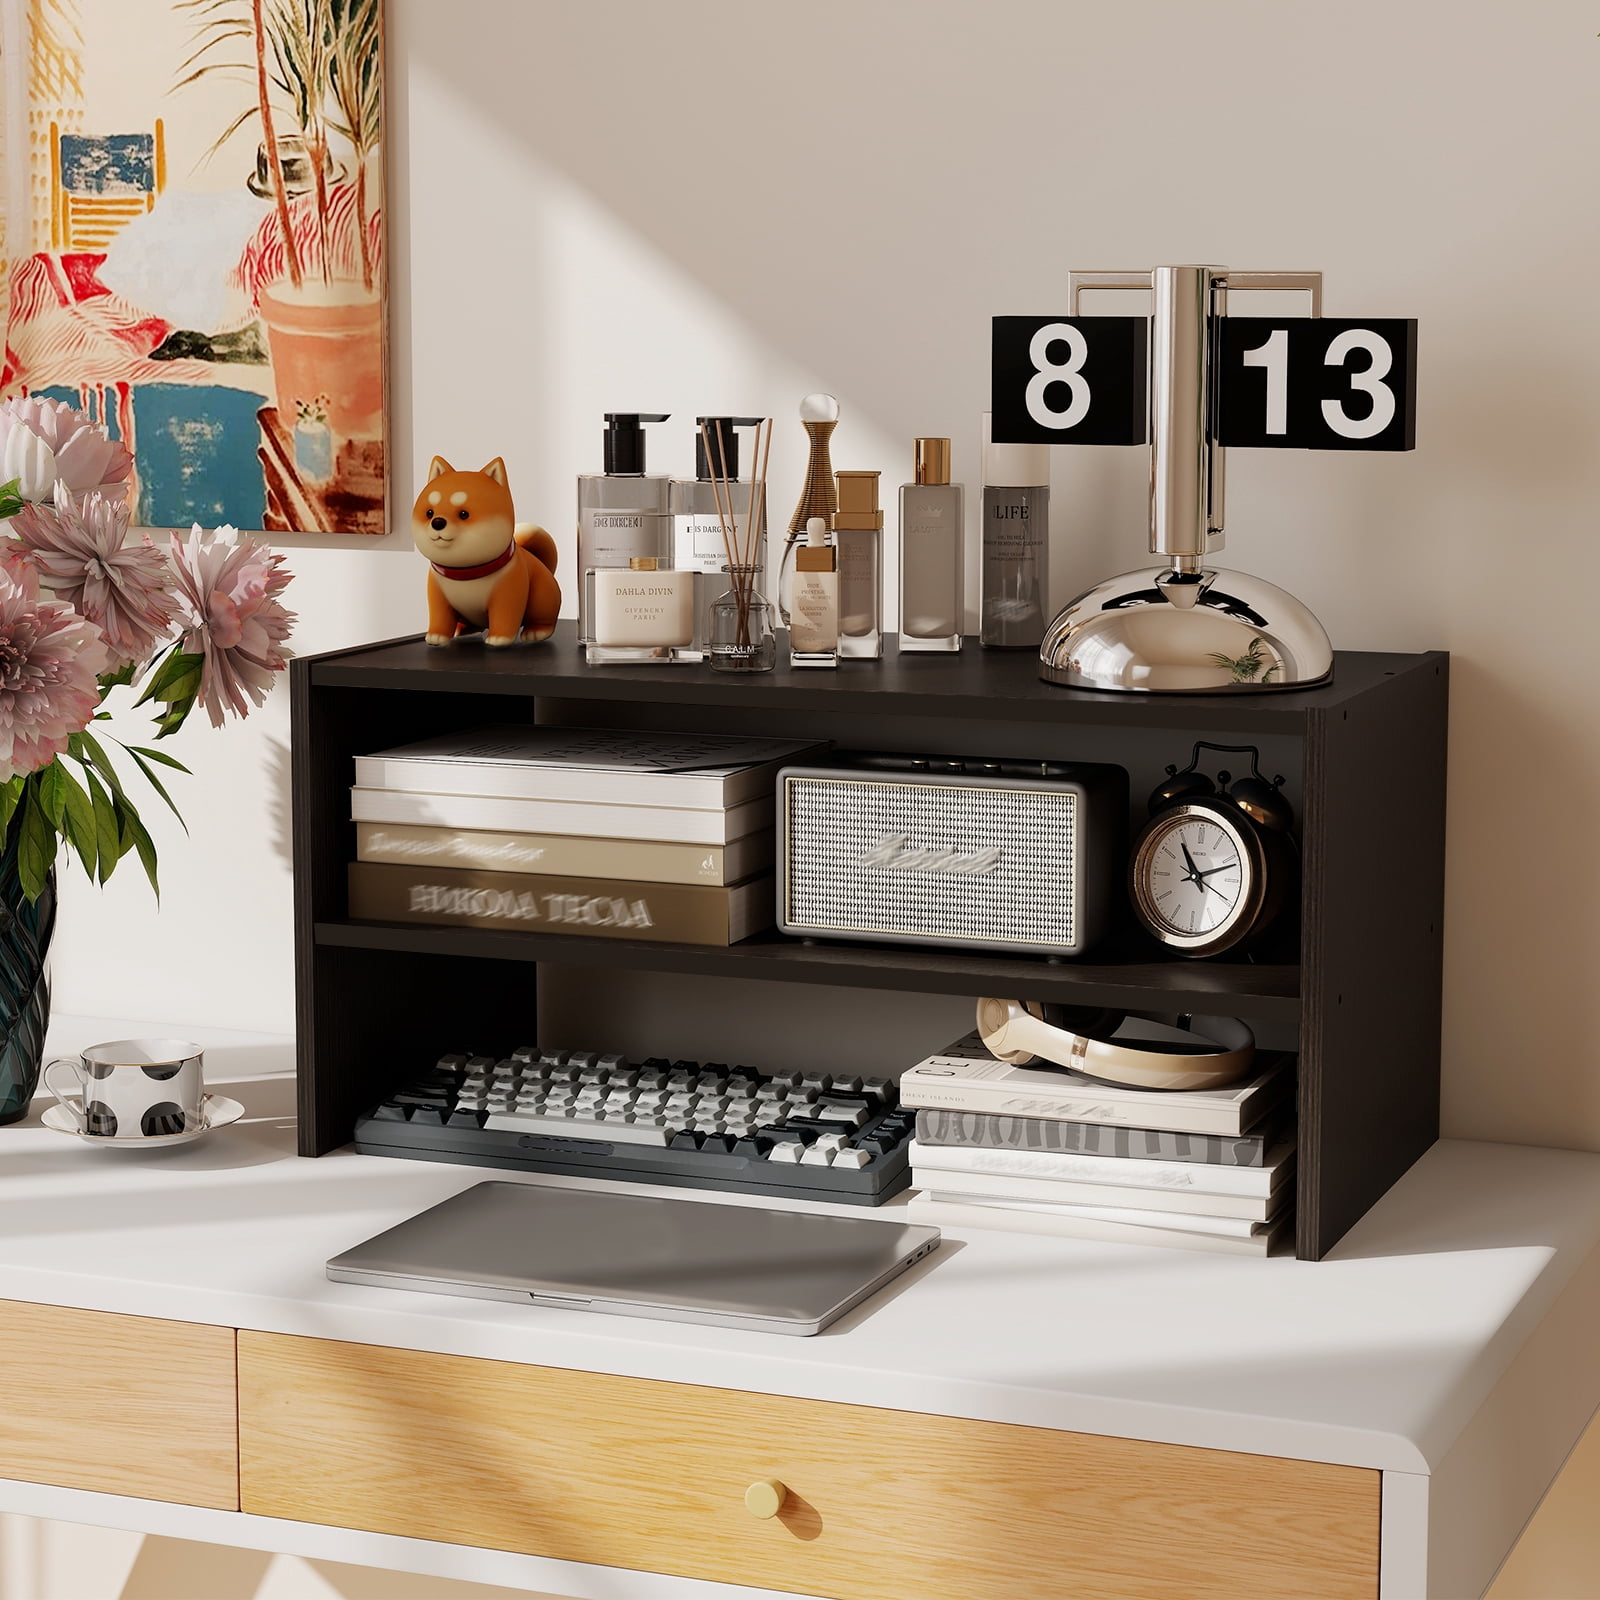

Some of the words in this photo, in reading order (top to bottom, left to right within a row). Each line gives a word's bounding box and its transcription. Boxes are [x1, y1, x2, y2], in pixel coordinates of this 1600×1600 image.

[1025, 322, 1091, 430] 8
[1243, 328, 1396, 439] 13
[996, 505, 1029, 520] LIFE
[615, 588, 645, 596] DAHLA
[648, 588, 673, 596] DIVIN
